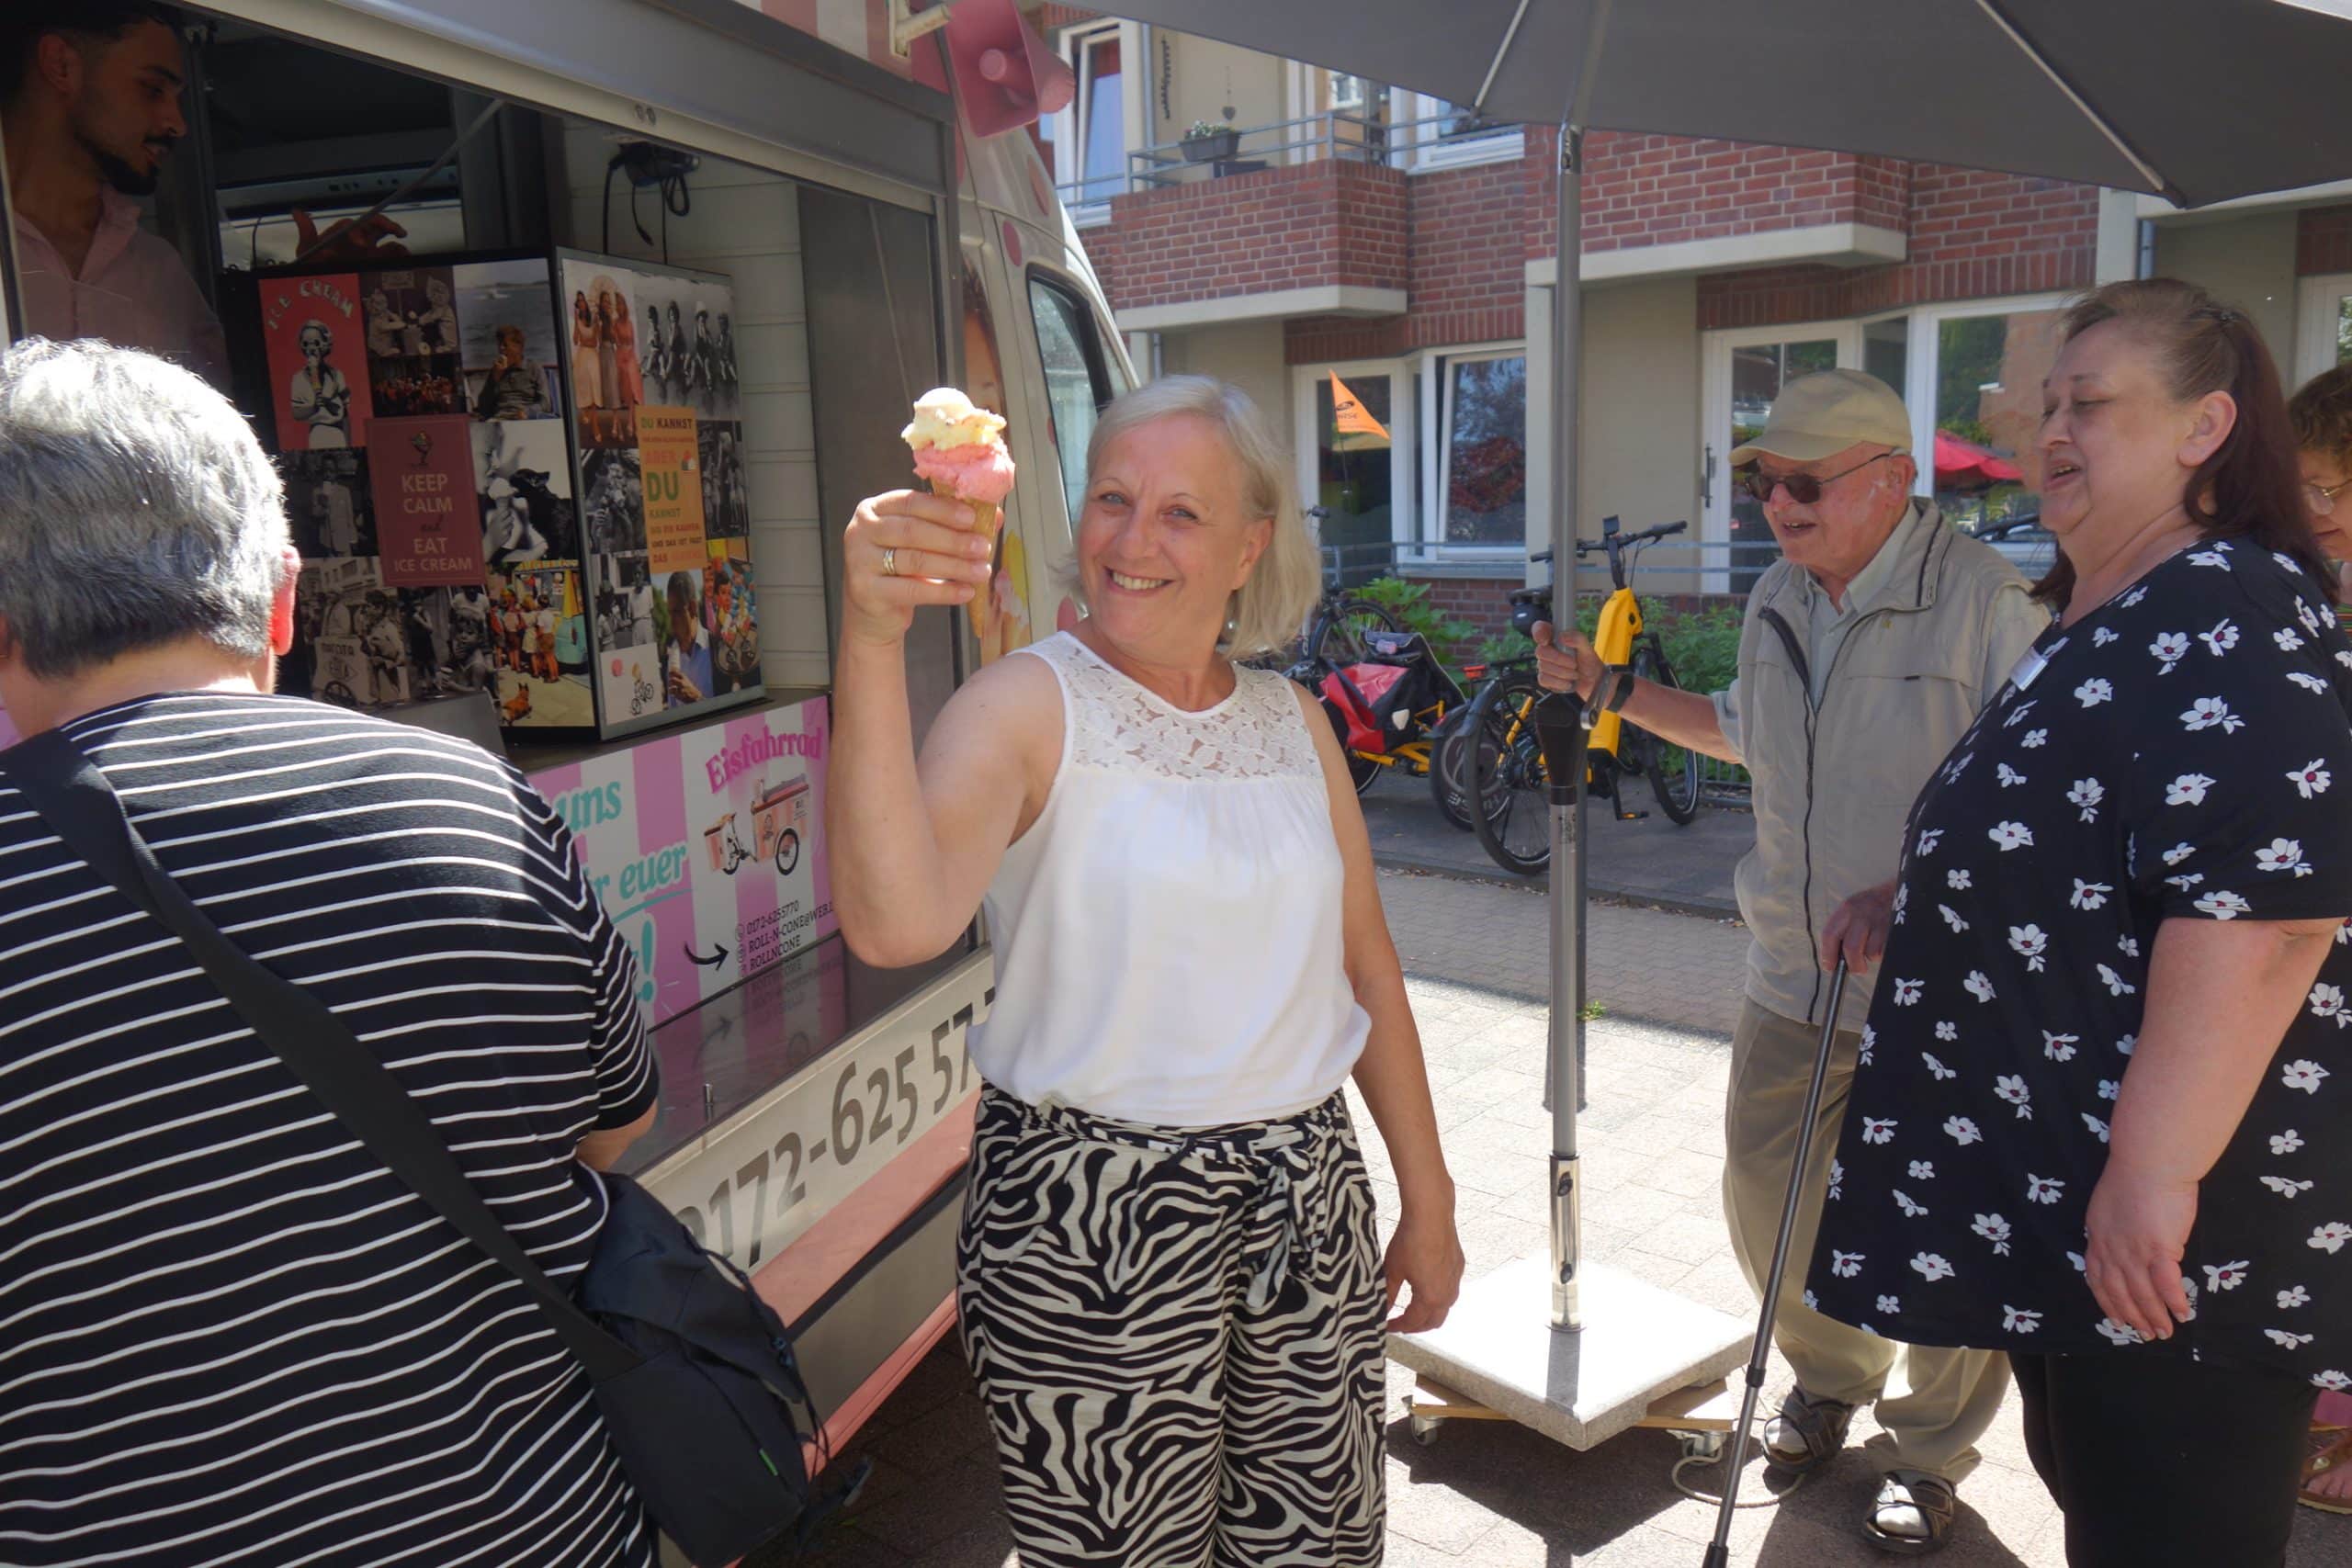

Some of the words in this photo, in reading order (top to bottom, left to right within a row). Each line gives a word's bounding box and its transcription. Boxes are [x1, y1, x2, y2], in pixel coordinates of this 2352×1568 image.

[300, 278, 354, 319] CREAM
[640, 417, 654, 429] DU
[657, 418, 693, 429] KANNST
[401, 473, 448, 492] KEEP
[646, 471, 679, 502] DU
[403, 497, 453, 513] CALM
[413, 537, 448, 554] EAT
[394, 558, 416, 572] ICE
[420, 558, 472, 571] CREAM
[705, 724, 824, 795] Eisfahrrad
[619, 845, 686, 899] euer
[750, 934, 801, 971] ROLLNCONE
